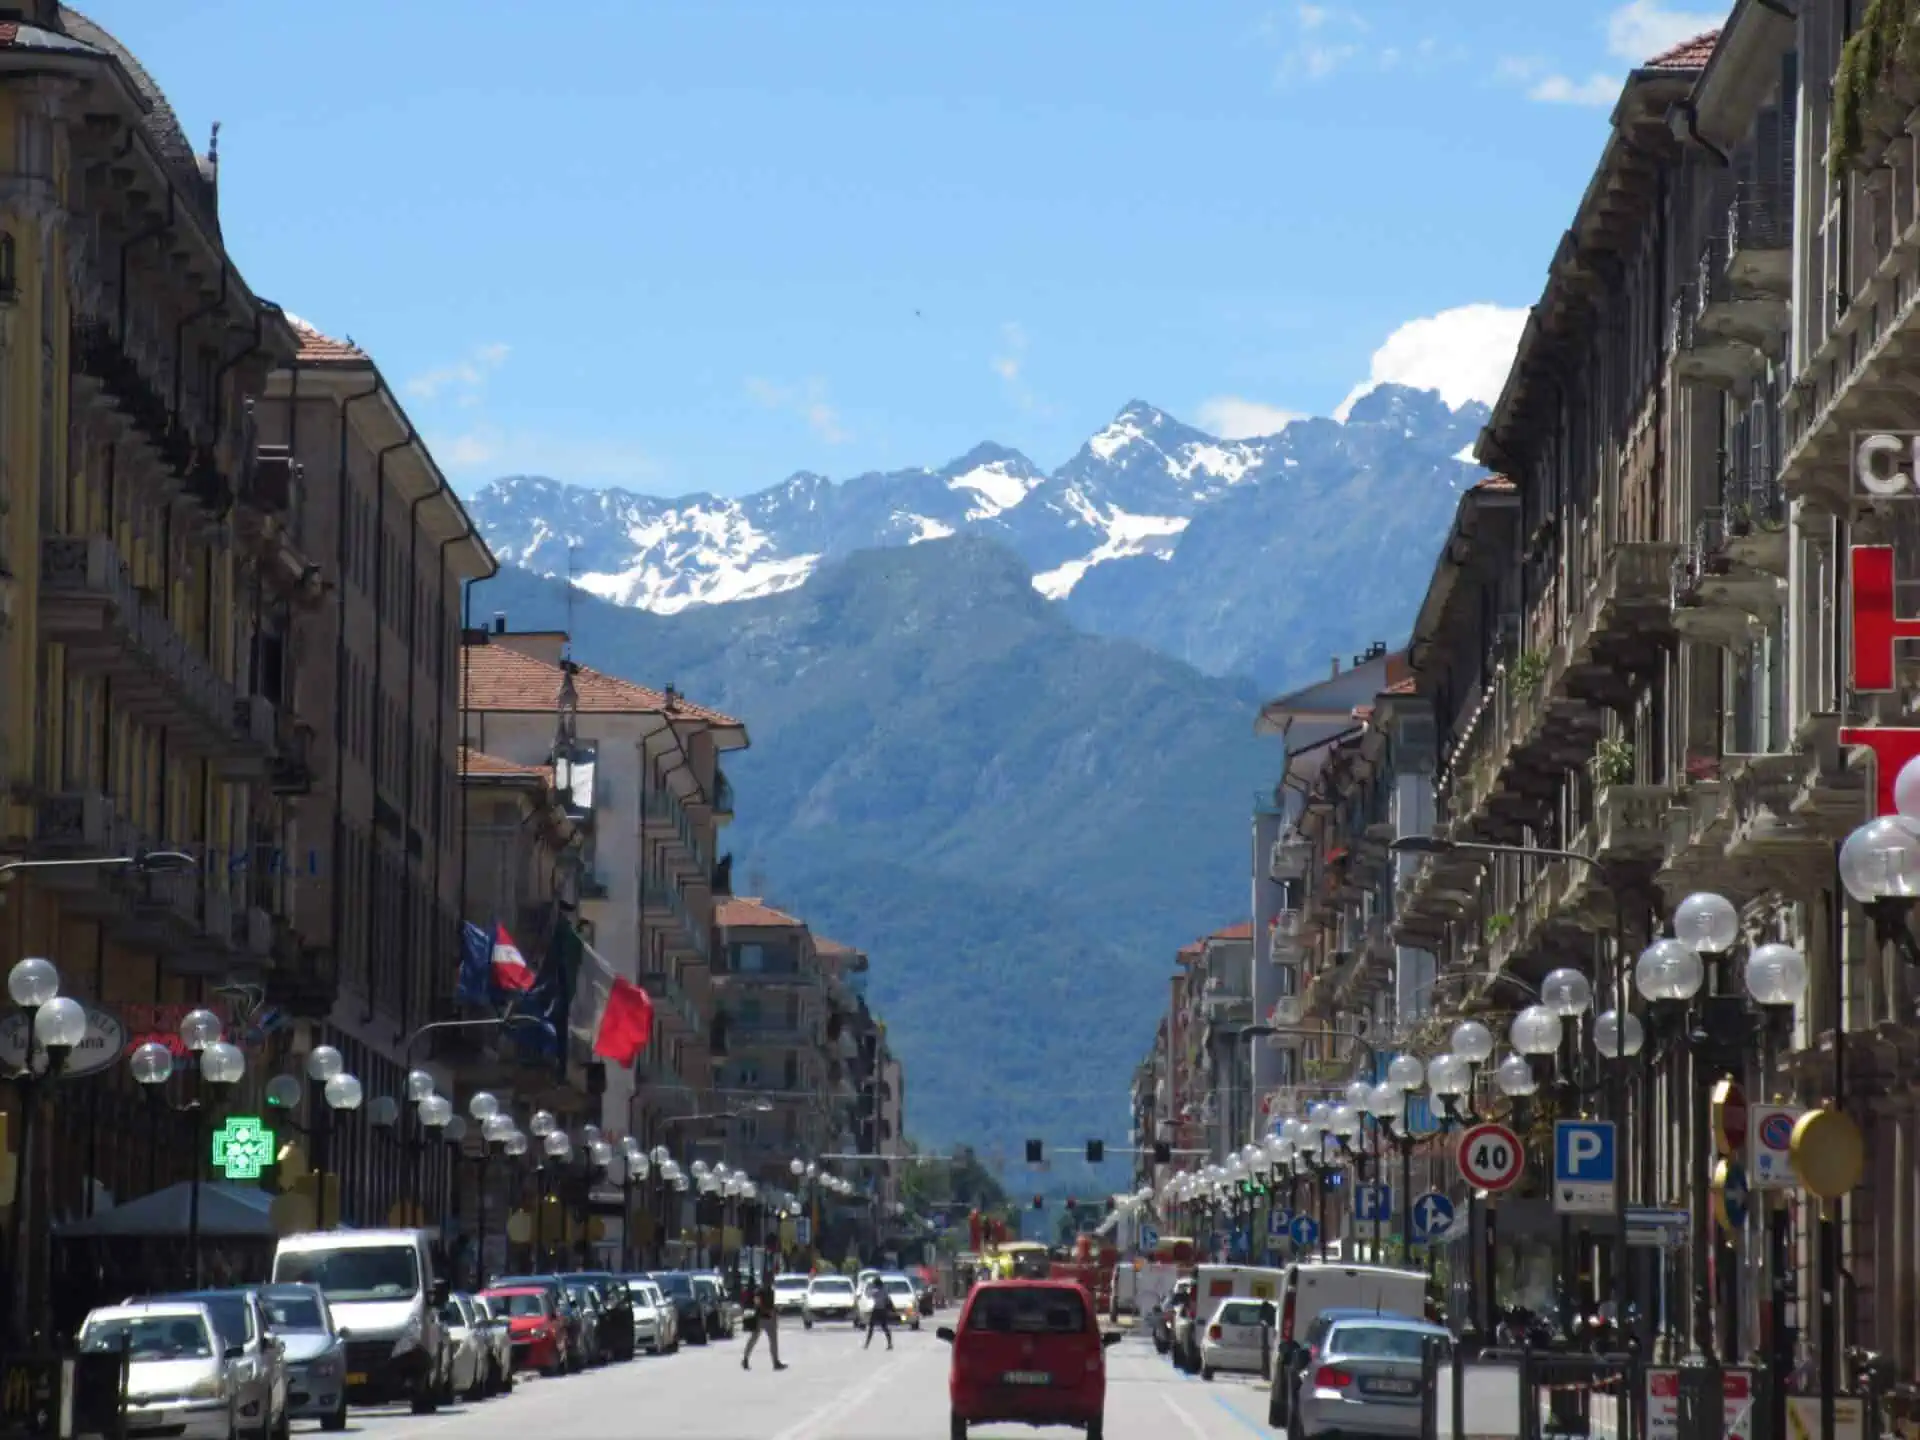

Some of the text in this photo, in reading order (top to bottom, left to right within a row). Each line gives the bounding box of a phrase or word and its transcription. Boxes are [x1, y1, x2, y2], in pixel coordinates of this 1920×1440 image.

[1856, 434, 1920, 495] C
[1474, 1144, 1508, 1171] 40
[1567, 1129, 1603, 1175] P
[1272, 1210, 1288, 1233] P
